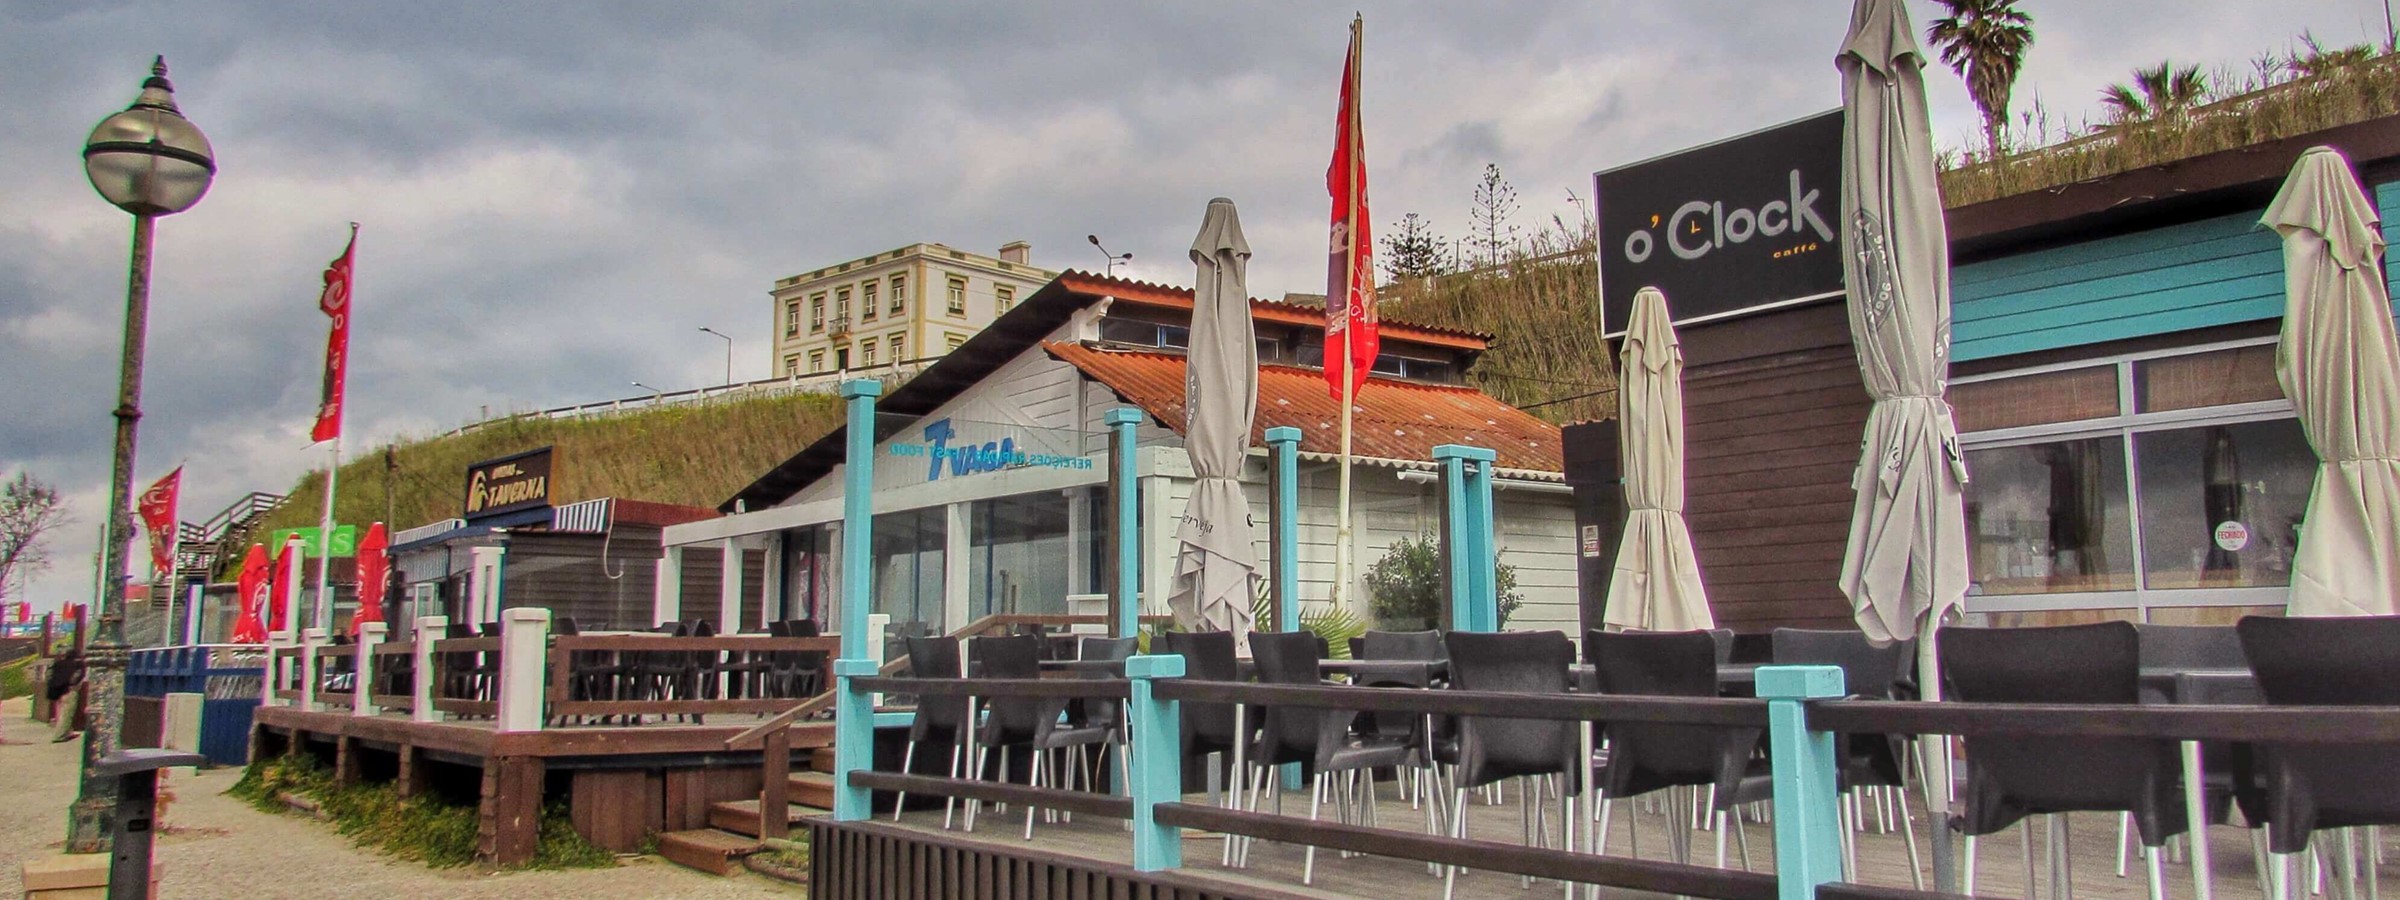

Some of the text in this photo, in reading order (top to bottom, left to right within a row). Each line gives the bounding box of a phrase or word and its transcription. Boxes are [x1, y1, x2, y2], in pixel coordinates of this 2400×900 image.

[950, 437, 1014, 476] VAGA
[488, 476, 545, 508] TAVERNA
[1182, 509, 1214, 538] erveja
